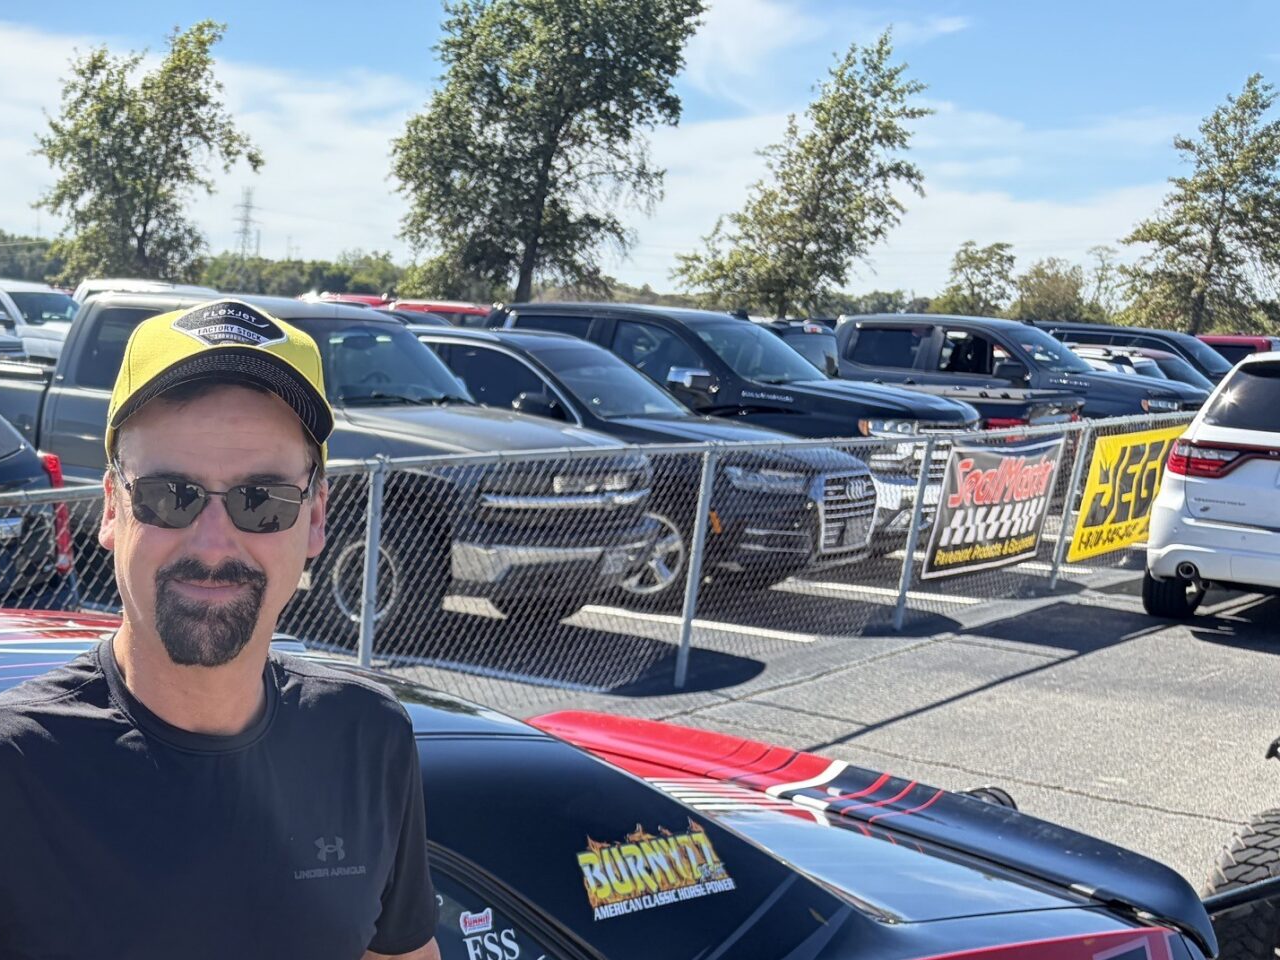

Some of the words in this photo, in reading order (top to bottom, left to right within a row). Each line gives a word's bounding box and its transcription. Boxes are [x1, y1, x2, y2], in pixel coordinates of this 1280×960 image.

[197, 324, 235, 336] FACTORY
[237, 327, 263, 342] STOCK
[294, 868, 329, 880] UNDER
[330, 865, 366, 877] ARMOUR
[594, 898, 643, 921] AMERICAN
[643, 890, 679, 909] CLASSIC
[678, 884, 705, 901] HORSE
[706, 877, 736, 894] POWER
